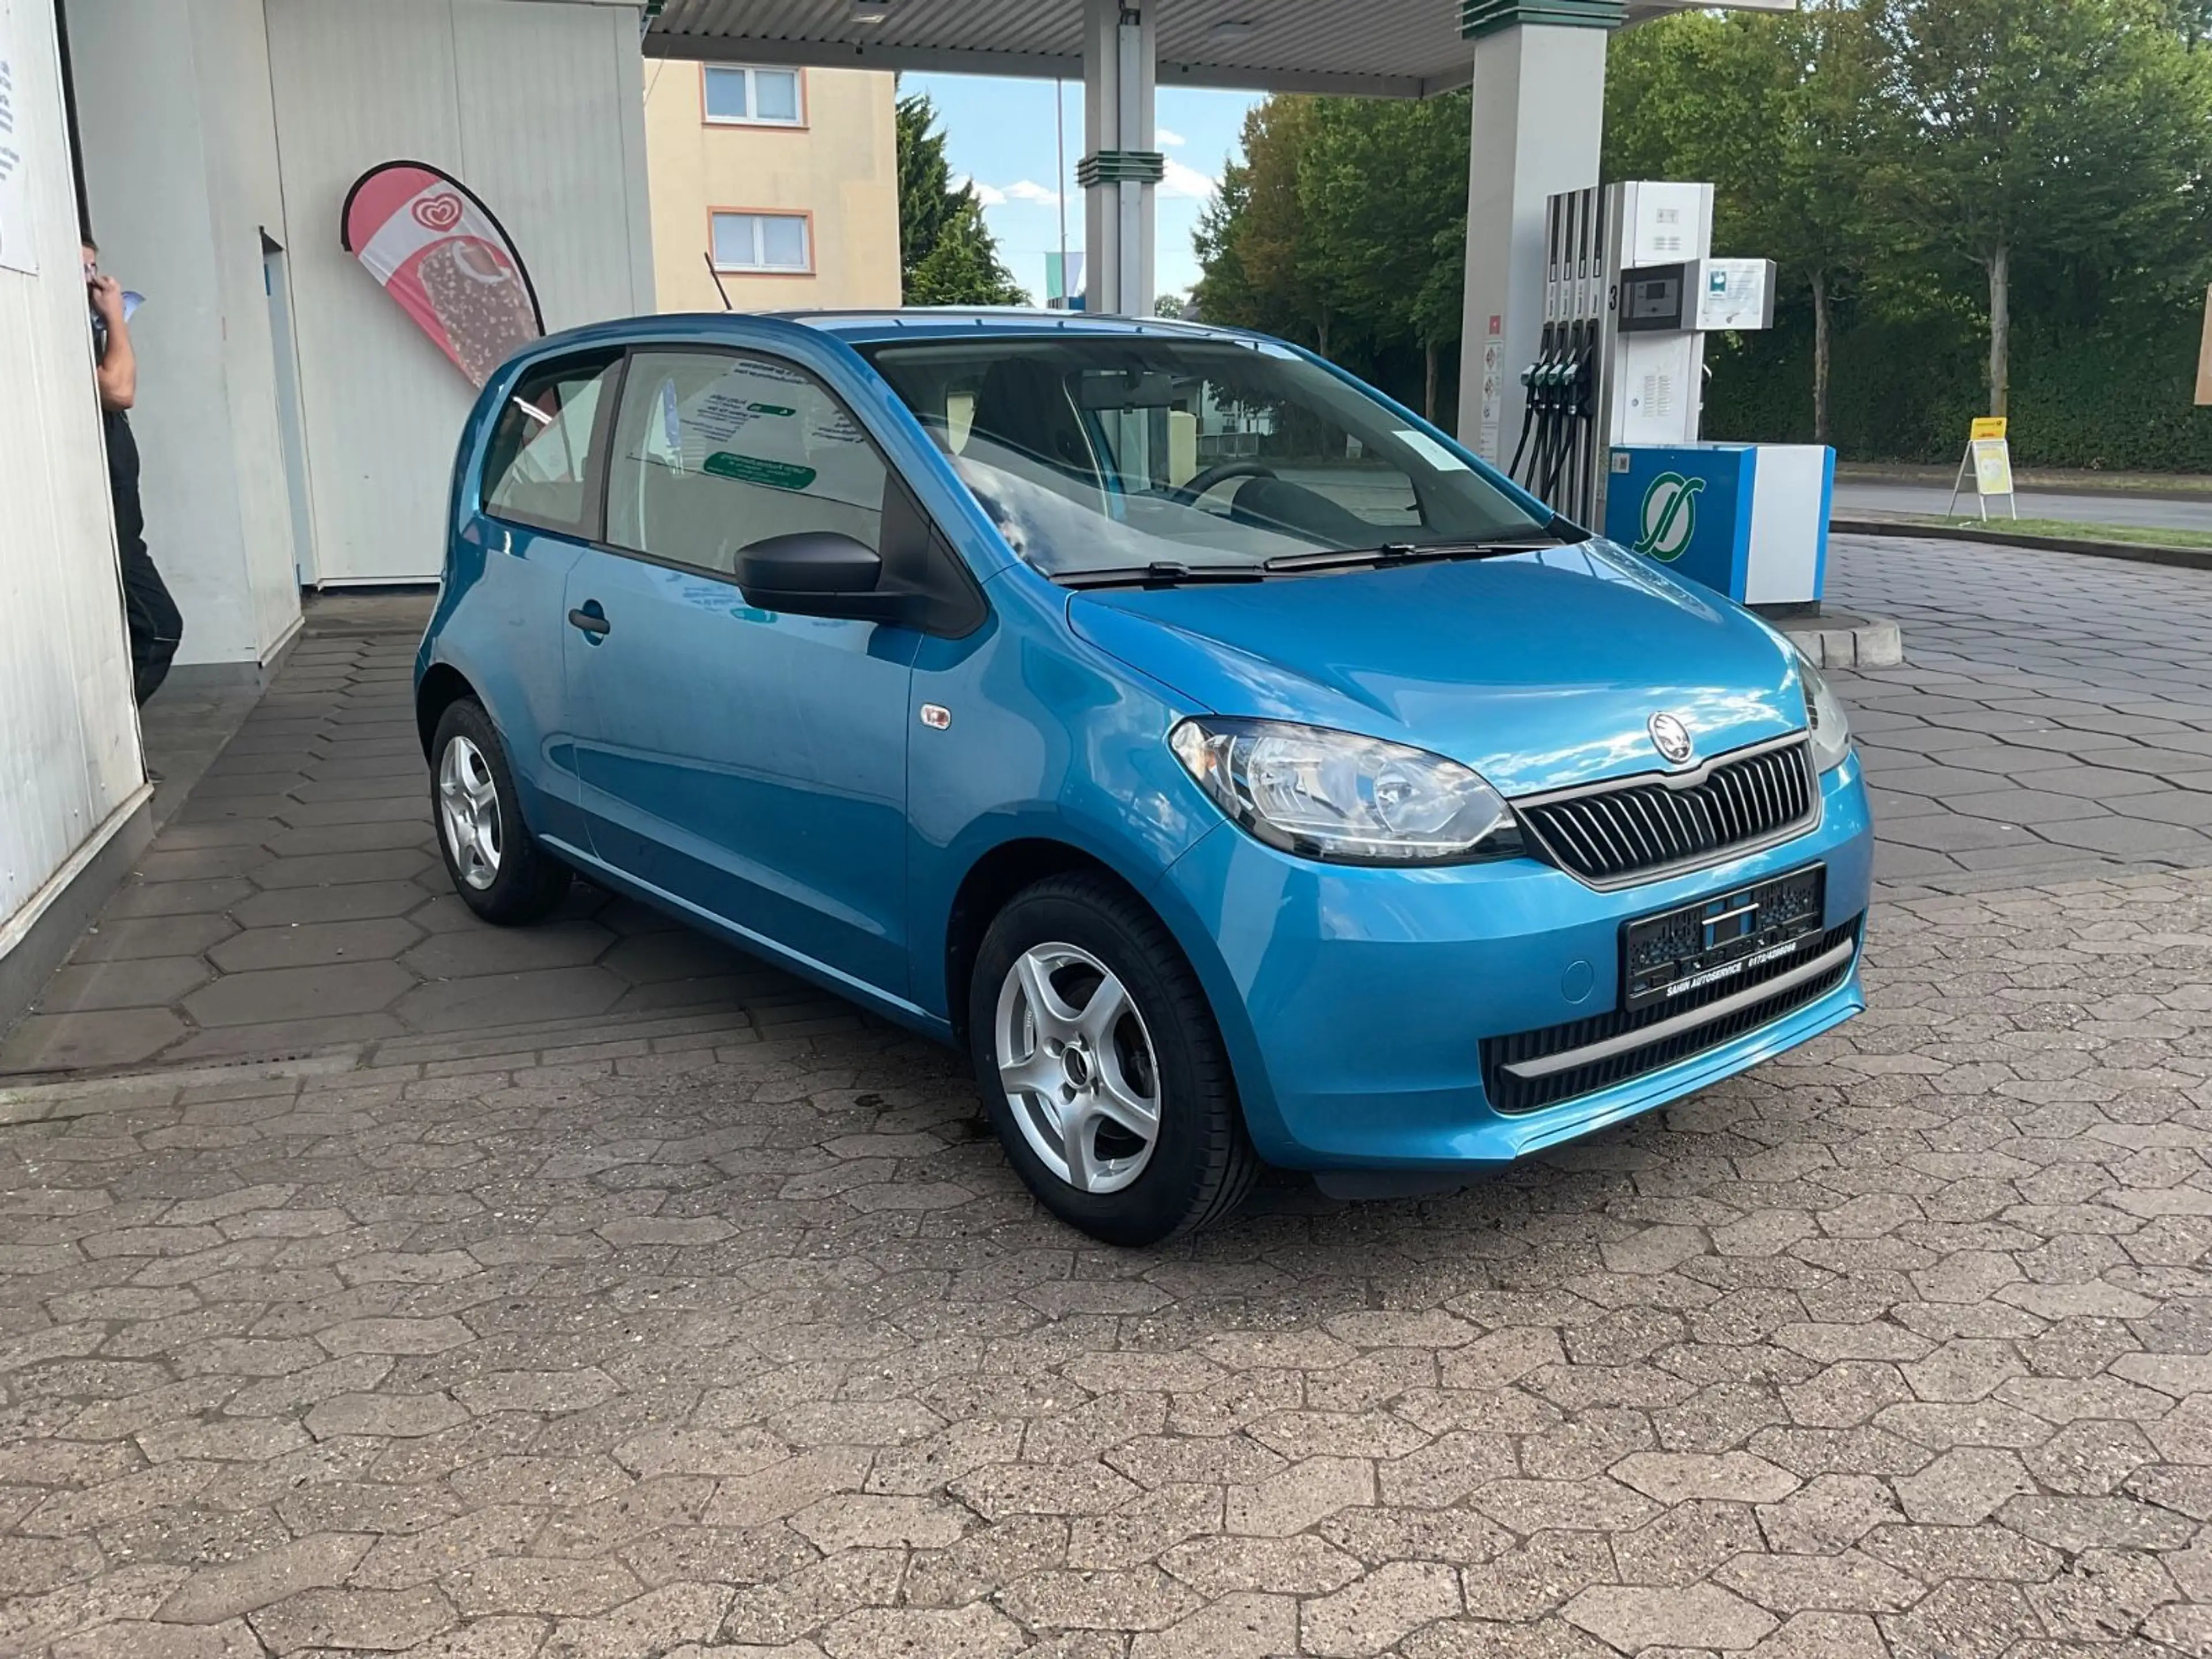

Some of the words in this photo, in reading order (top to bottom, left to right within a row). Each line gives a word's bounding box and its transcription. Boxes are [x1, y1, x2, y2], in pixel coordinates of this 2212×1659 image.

[1609, 285, 1617, 310] 3
[1666, 980, 1691, 997] SAHIN
[1691, 962, 1743, 989] AUTOSERVICE
